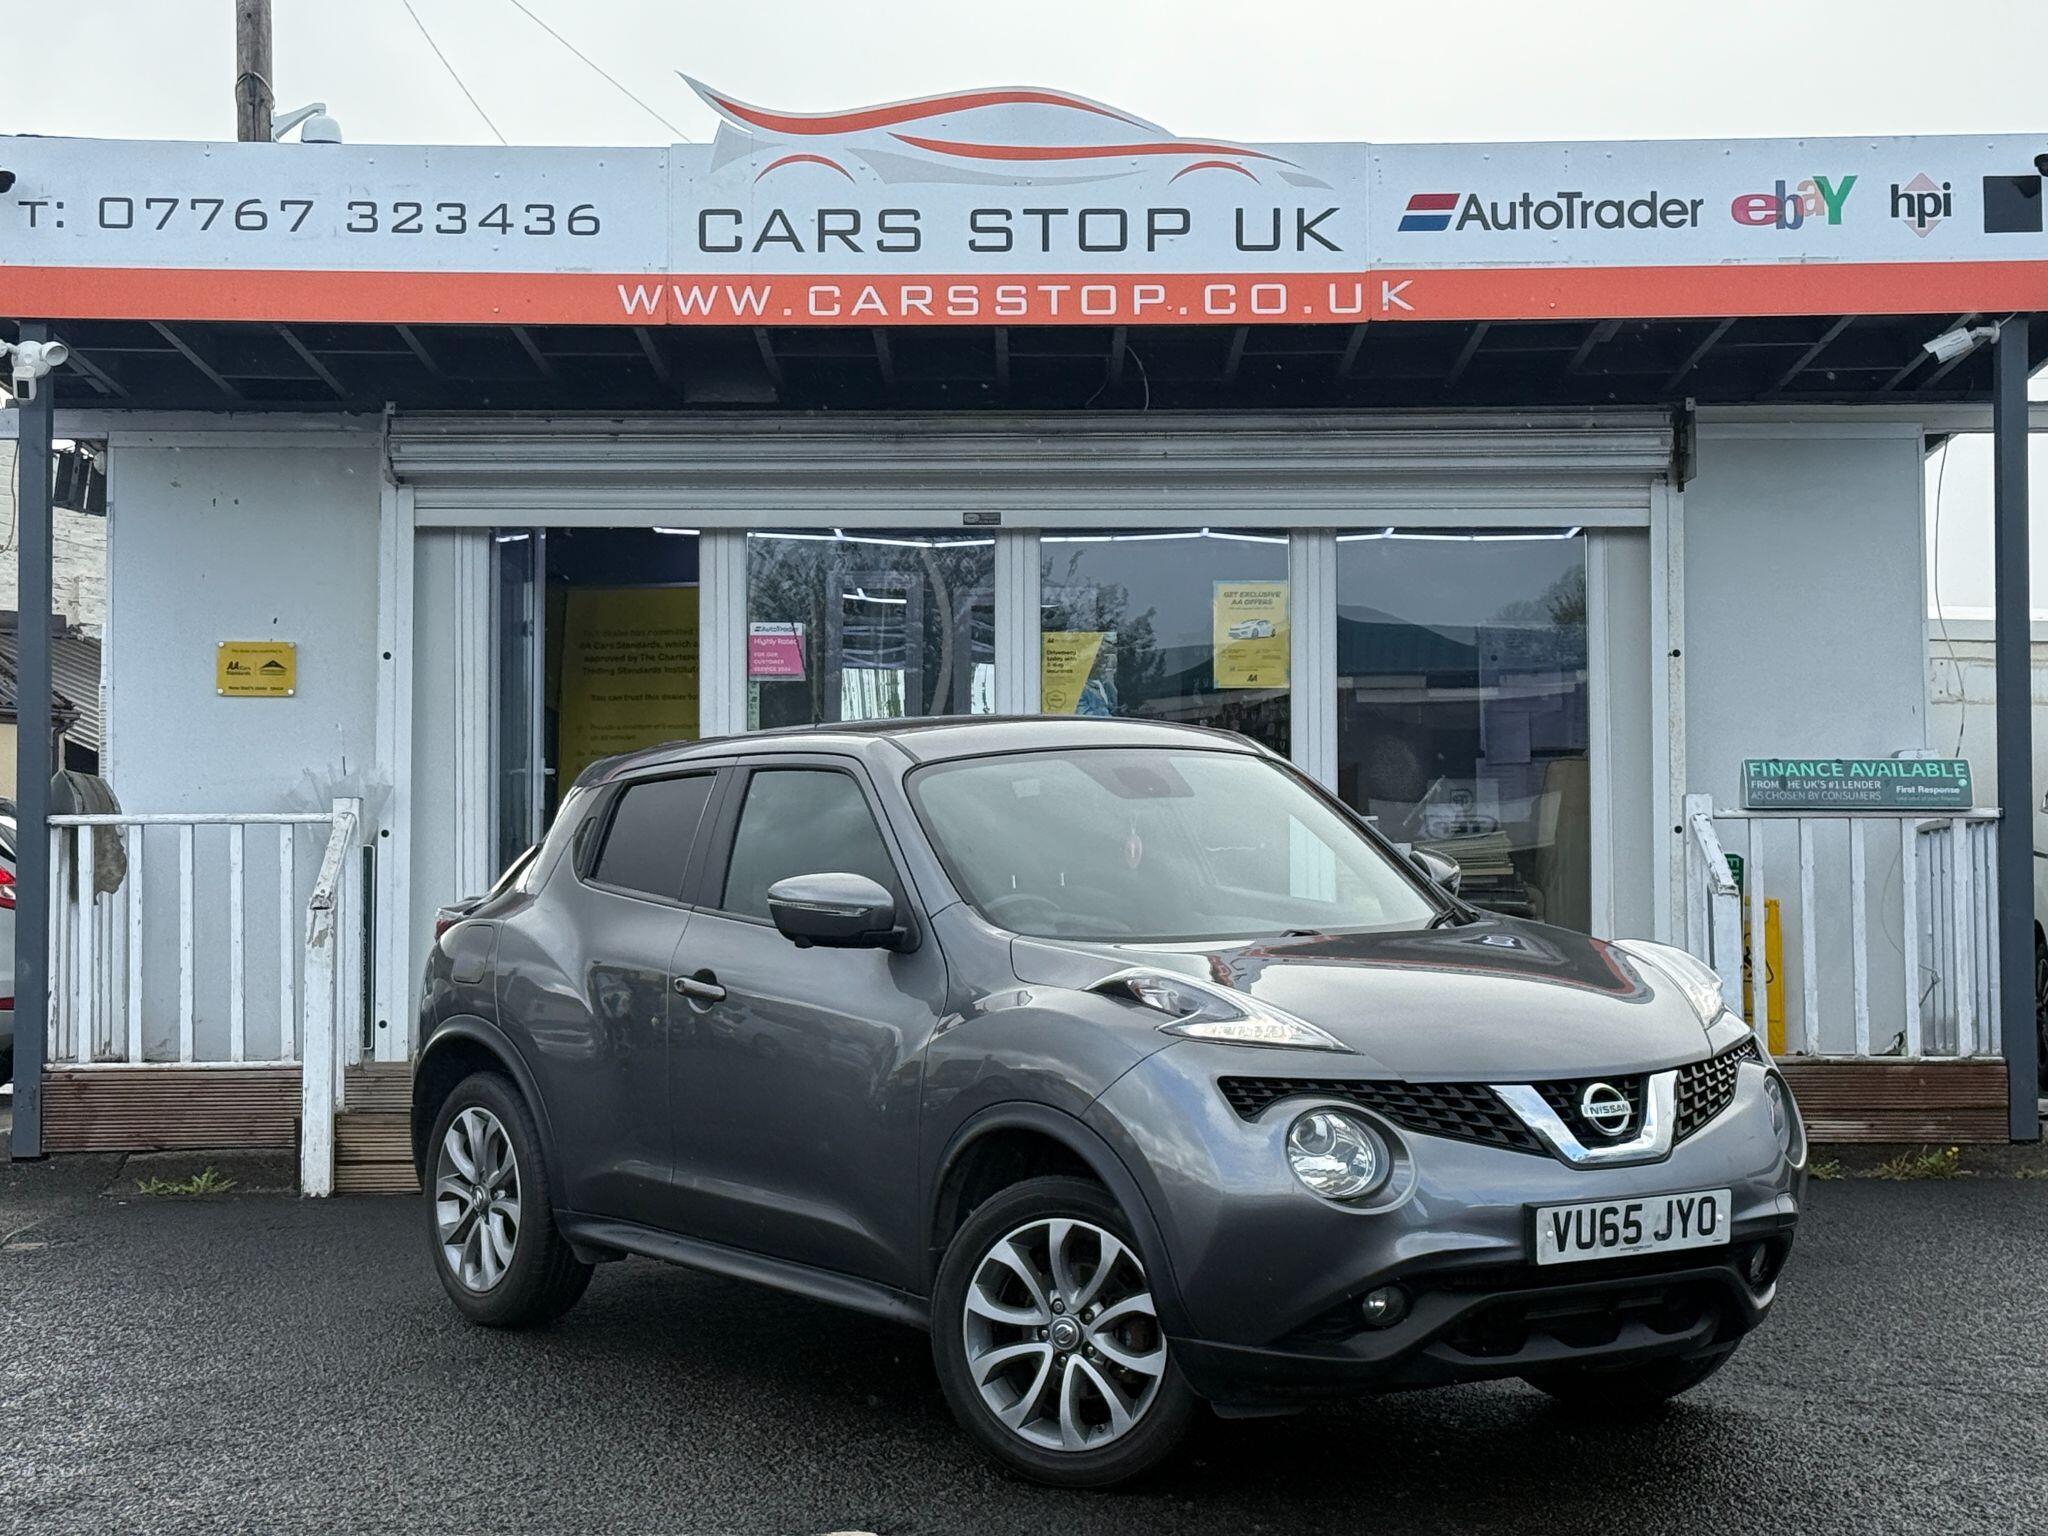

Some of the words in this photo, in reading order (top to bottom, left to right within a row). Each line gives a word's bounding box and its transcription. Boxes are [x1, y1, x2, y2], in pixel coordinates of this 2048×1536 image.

[18, 200, 66, 229] T:
[99, 197, 315, 232] 07767
[346, 200, 602, 237] 323436
[1454, 191, 1704, 231] AutoTrader
[1889, 181, 1953, 232] hpi
[699, 208, 922, 254] CARS
[968, 207, 1192, 253] STOP
[1234, 207, 1344, 253] UK
[617, 280, 1416, 318] WWW.CARSSTOP.CO.UK
[1749, 762, 1845, 778] FINANCE
[1850, 762, 1969, 779] AVAILABLE
[1751, 780, 1780, 789] FROM
[1803, 779, 1827, 789] UK'S
[1842, 780, 1882, 789] LENDER
[1765, 791, 1806, 801] CHOSEN
[1808, 791, 1820, 801] BY
[1821, 790, 1882, 801] CONSUMERS
[1896, 785, 1915, 794] First
[1918, 786, 1960, 795] Response
[1589, 1103, 1630, 1115] NISSAN
[1552, 1203, 1643, 1253] VU65
[1653, 1196, 1717, 1242] JYO
